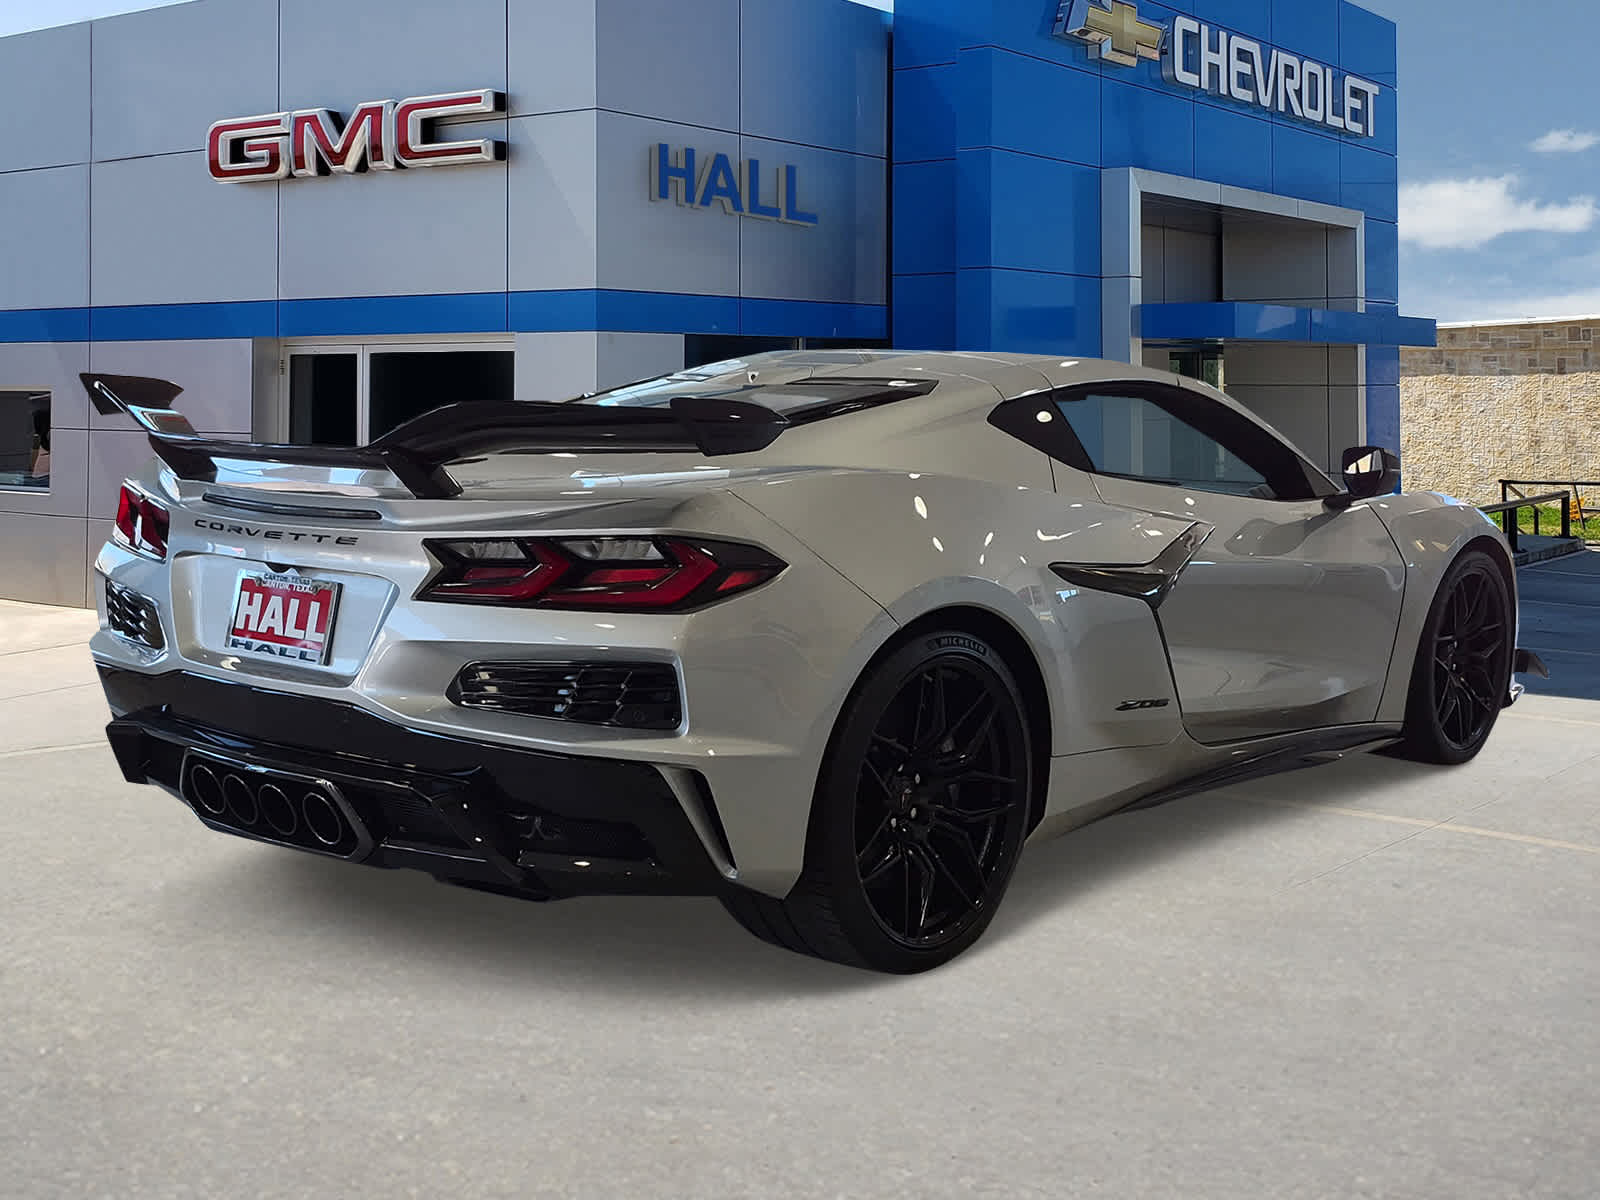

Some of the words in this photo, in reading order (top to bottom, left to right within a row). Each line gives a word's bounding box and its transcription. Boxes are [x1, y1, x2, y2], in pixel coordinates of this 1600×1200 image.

[1173, 15, 1380, 137] CHEVROLET
[208, 88, 507, 184] GMC
[650, 142, 819, 226] HALL
[194, 519, 359, 546] CORVETTE
[230, 638, 317, 662] HALL
[235, 590, 325, 643] HALL
